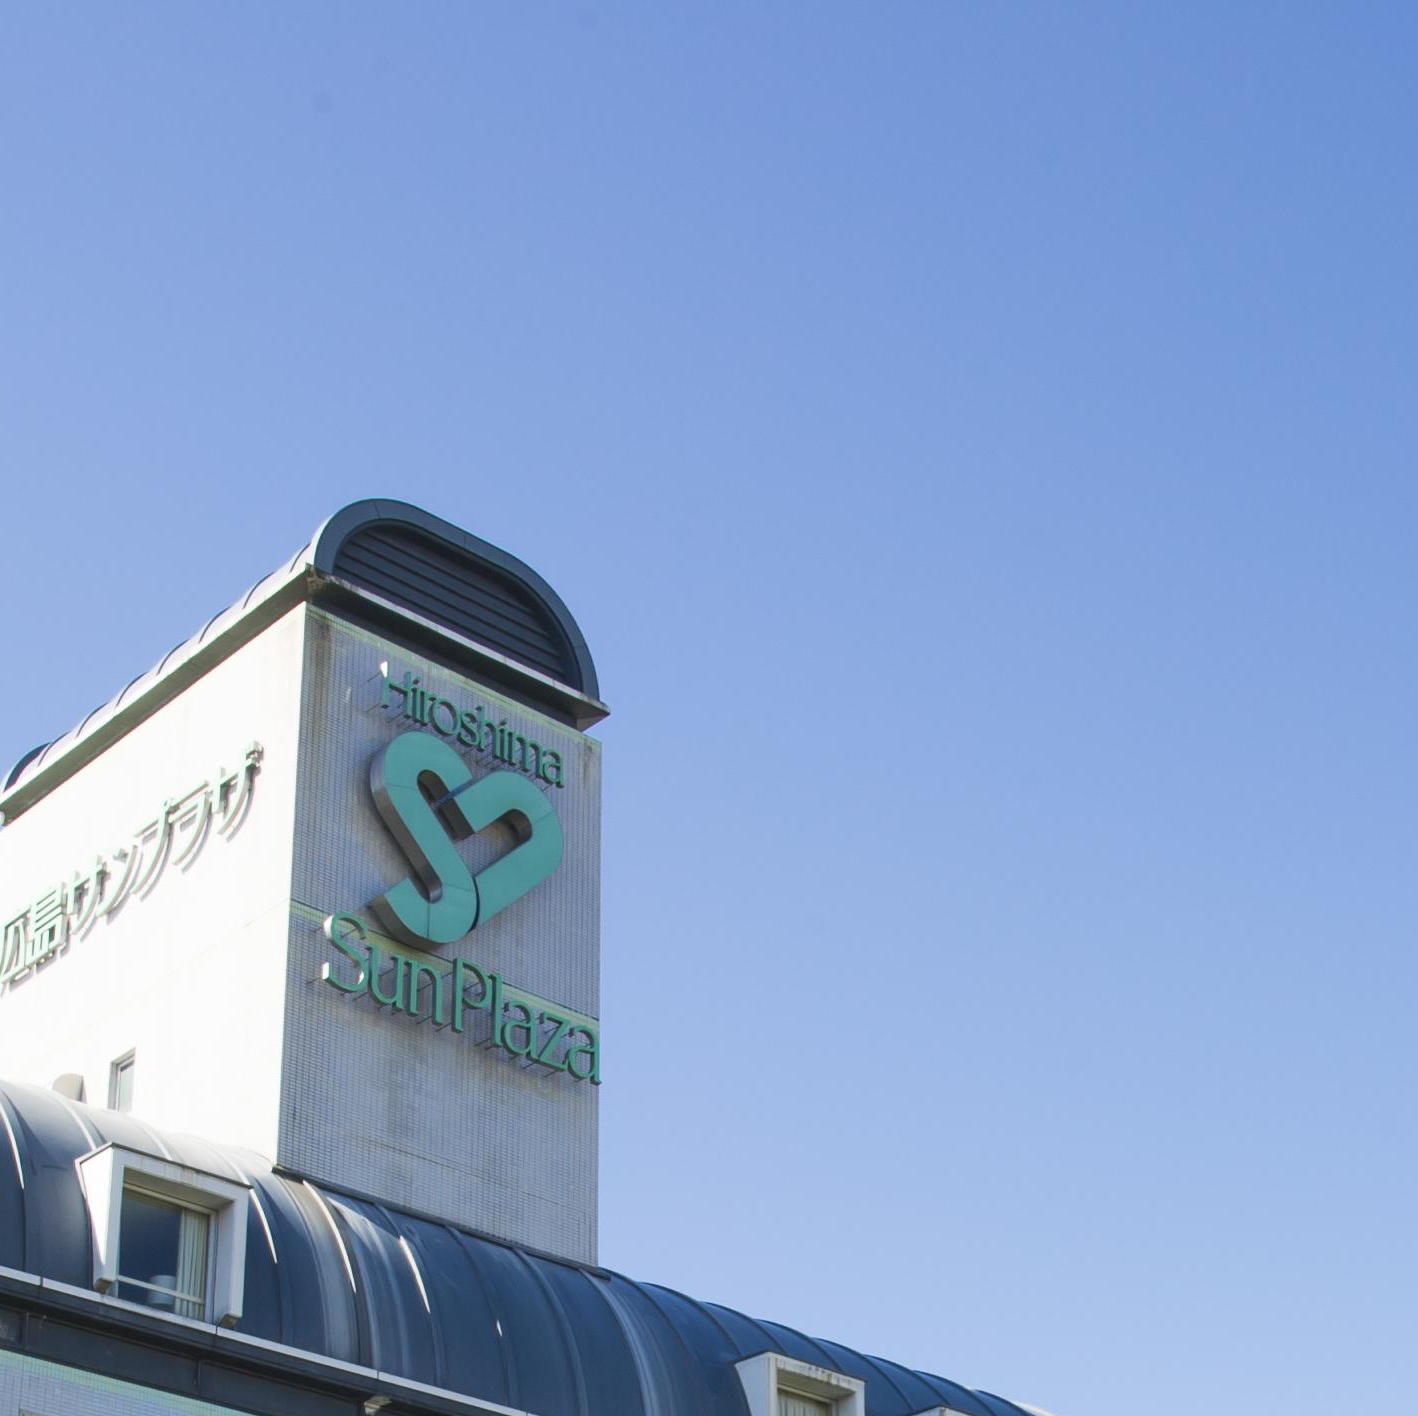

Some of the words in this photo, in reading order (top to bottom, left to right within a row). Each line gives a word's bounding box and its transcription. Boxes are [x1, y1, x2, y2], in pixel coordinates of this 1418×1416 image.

[380, 661, 565, 788] Hiroshima
[322, 911, 443, 1026] Sun
[452, 957, 602, 1086] Plaza
